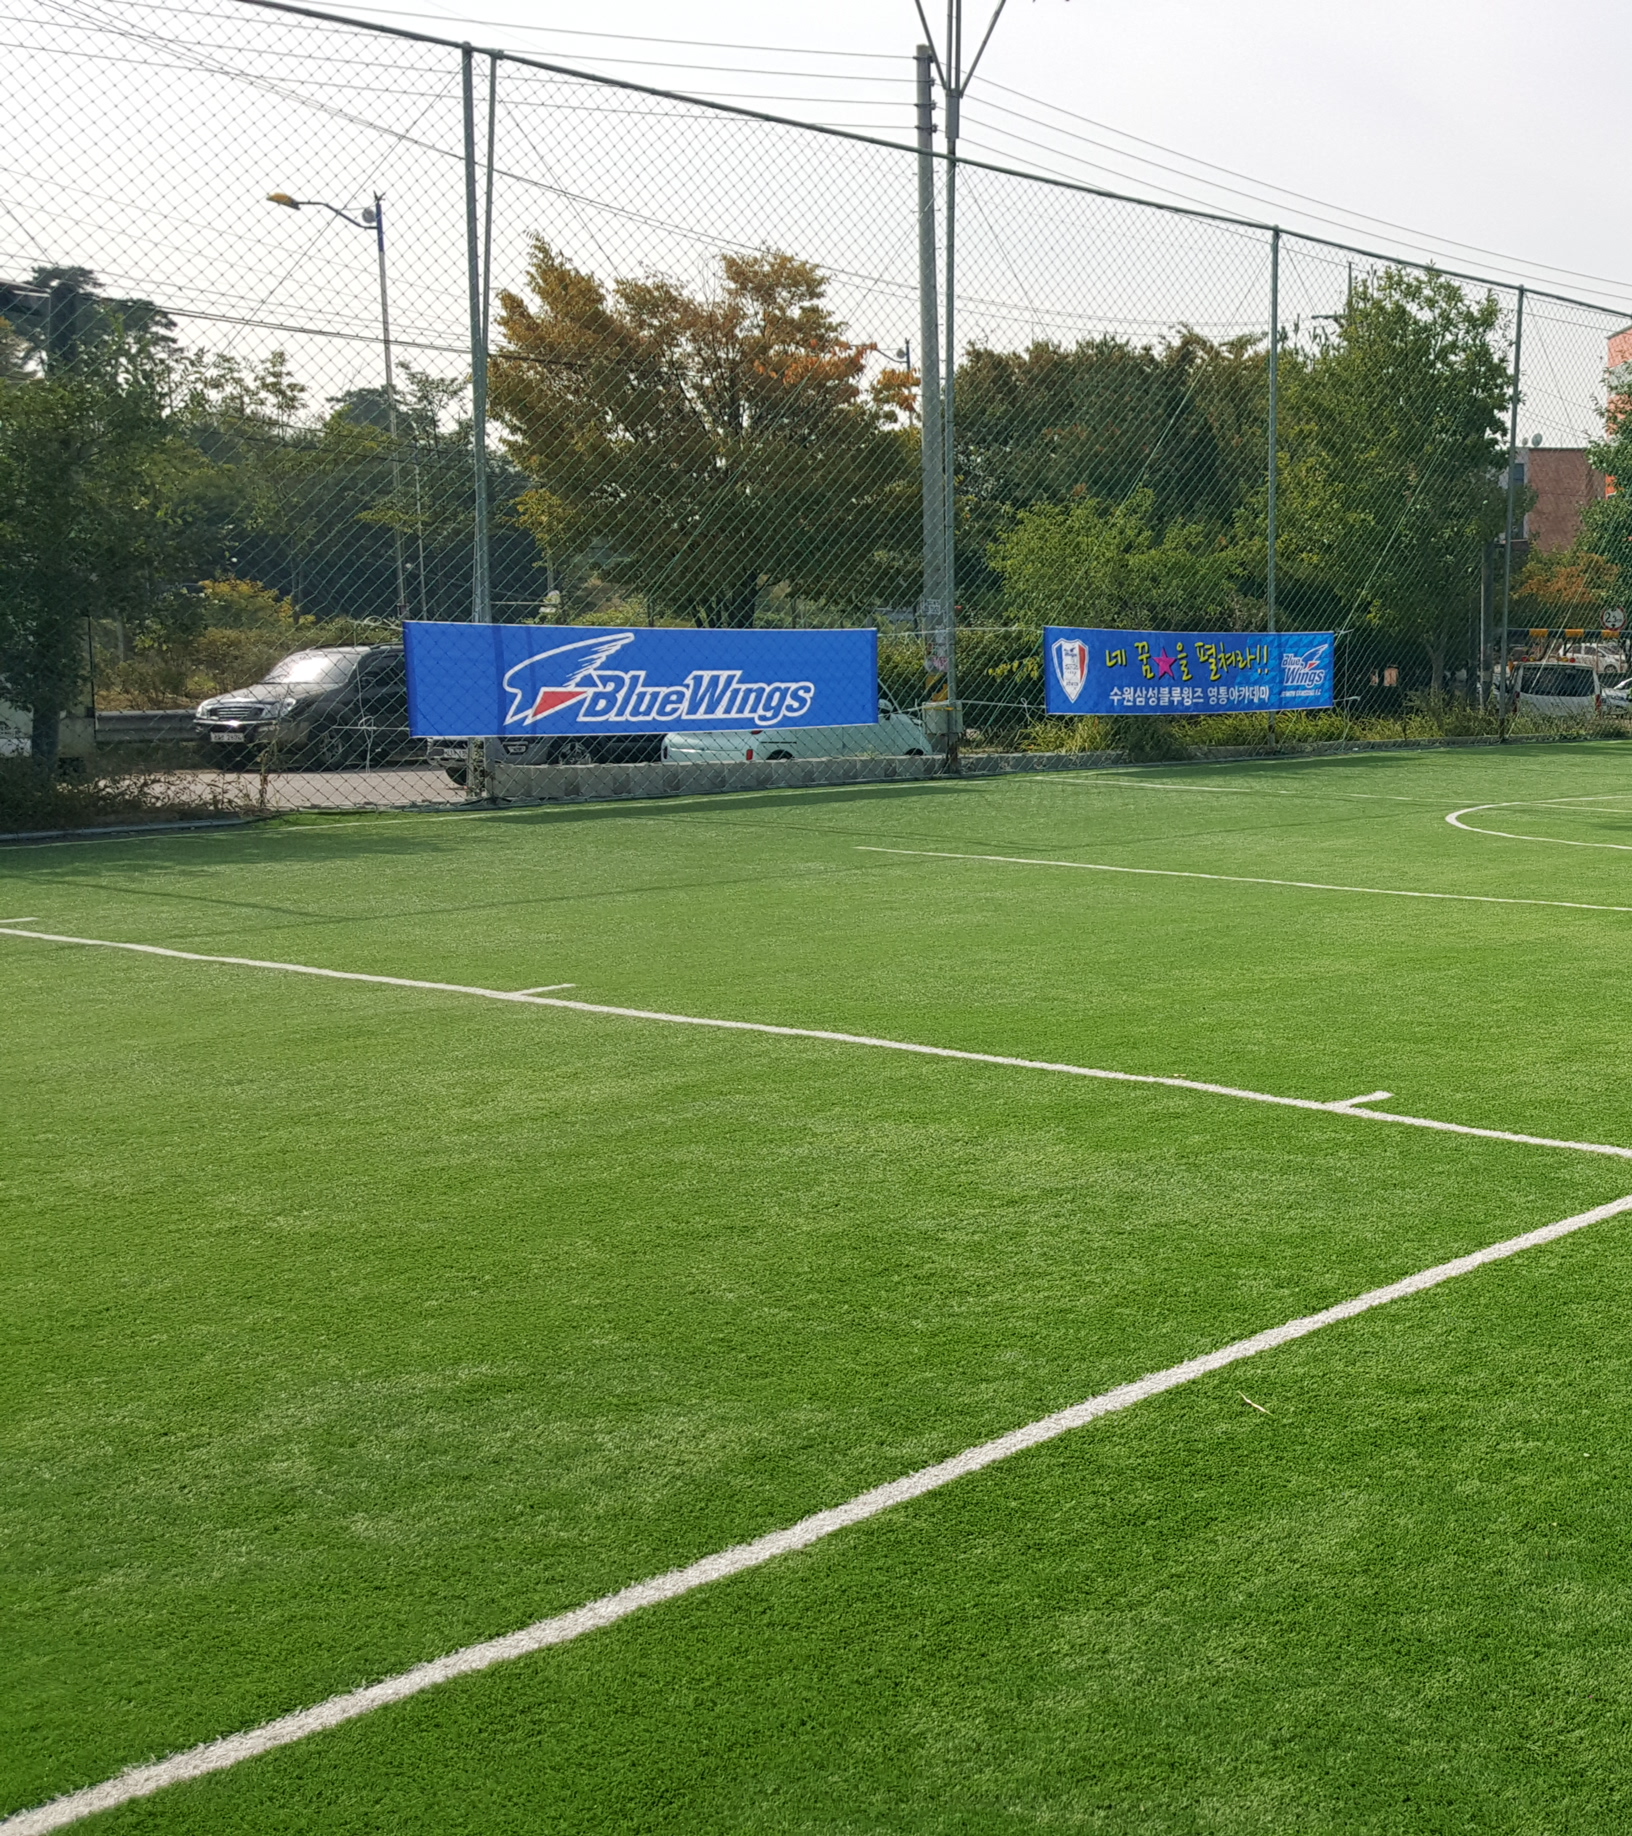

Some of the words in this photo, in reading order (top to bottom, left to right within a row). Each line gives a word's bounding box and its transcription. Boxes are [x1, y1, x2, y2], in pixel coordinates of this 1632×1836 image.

[1106, 649, 1127, 666] 네
[1195, 641, 1269, 681] 펼쳐라!!
[1281, 653, 1303, 668] Blue
[1284, 665, 1325, 689] Wings
[576, 670, 815, 726] BlueWings
[1109, 686, 1204, 707] 수원삼성블루윙즈
[1207, 685, 1270, 705] 영통아카데미
